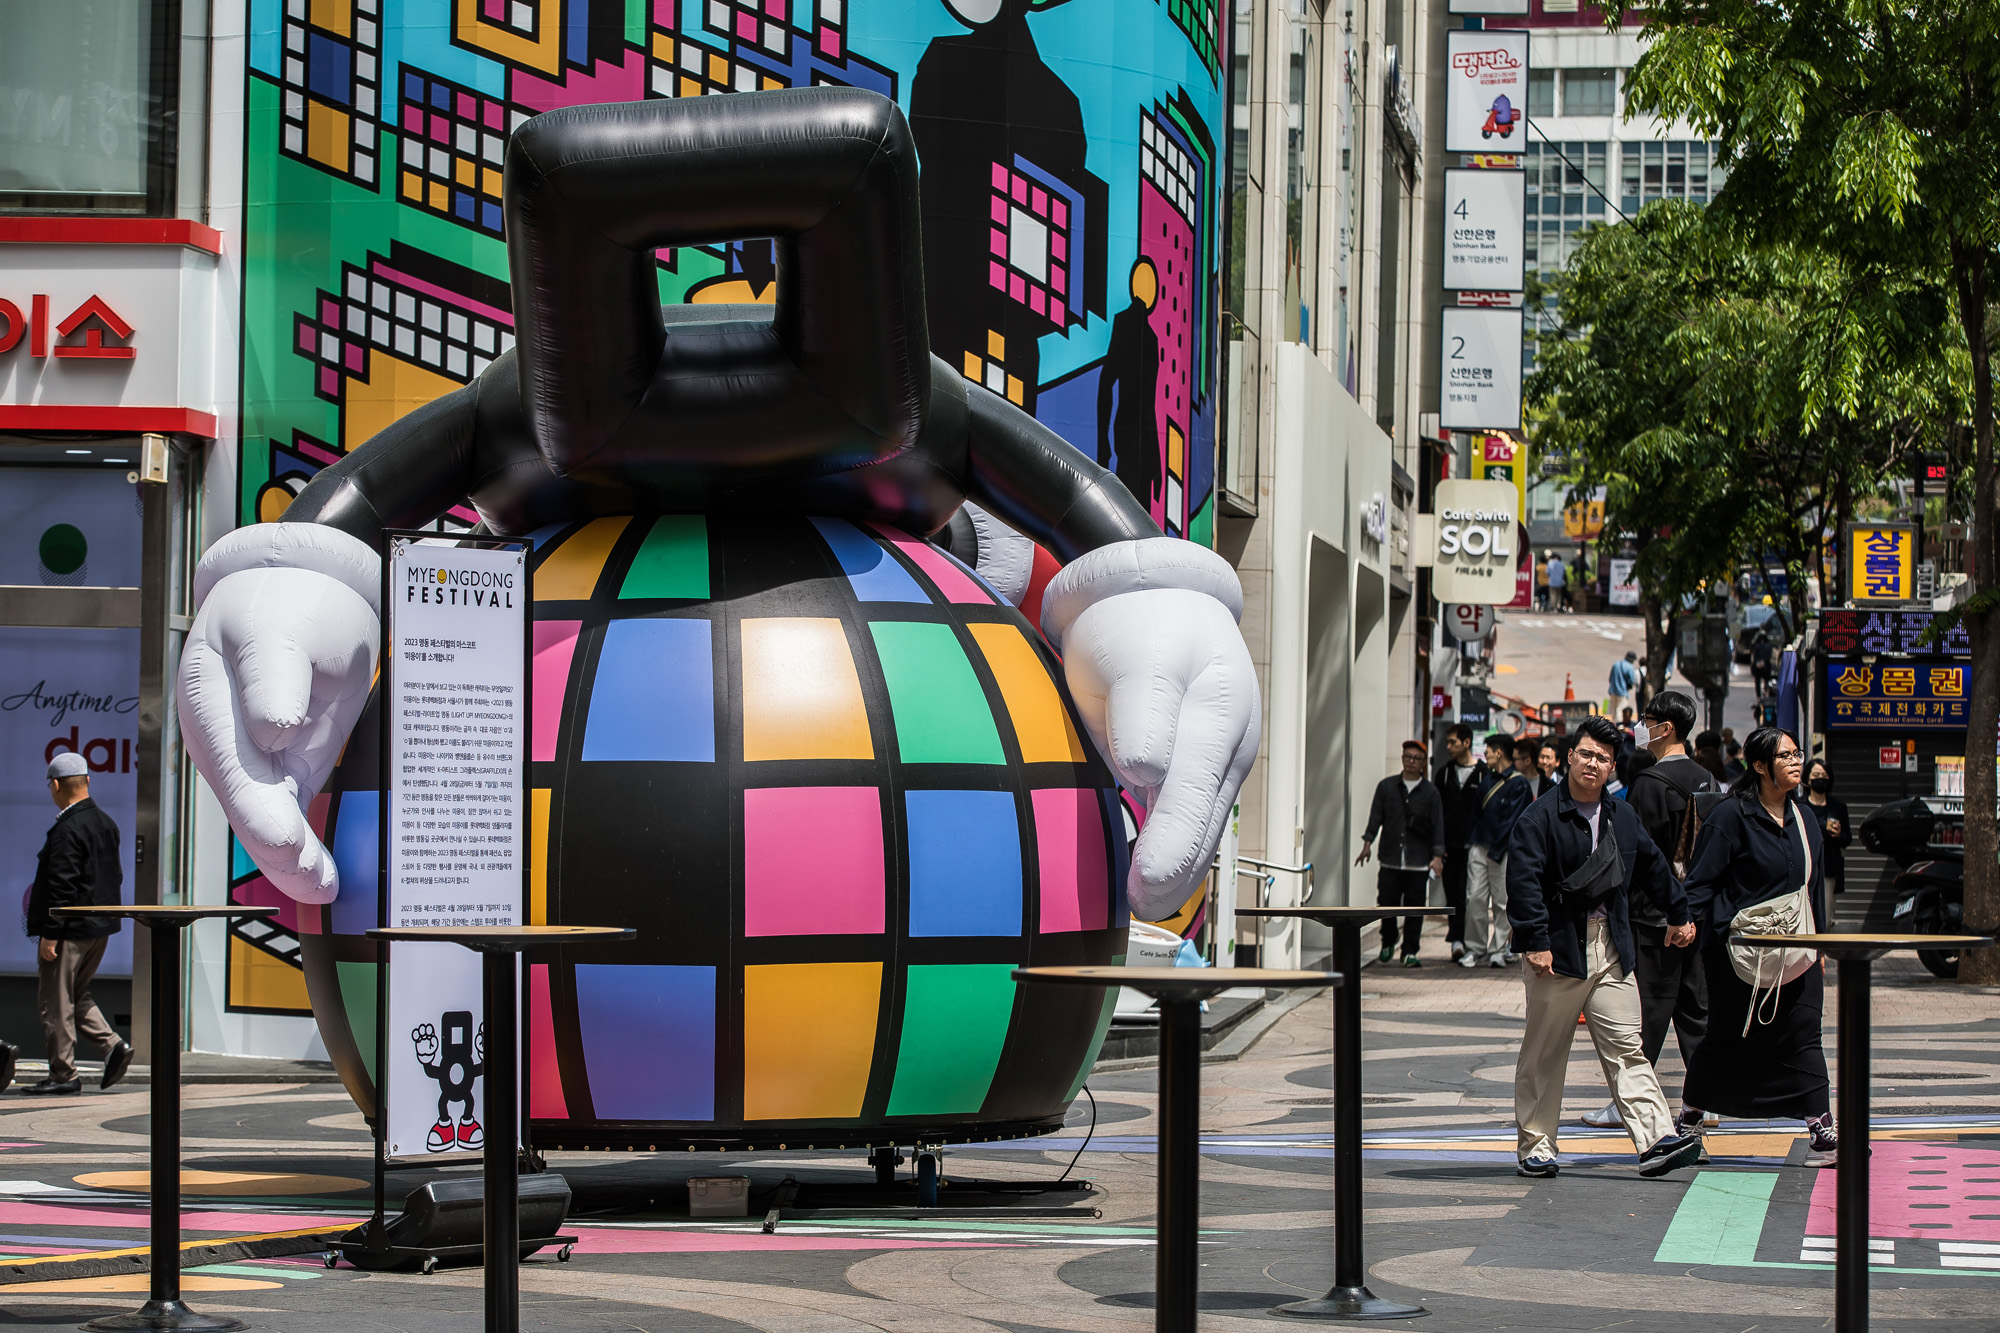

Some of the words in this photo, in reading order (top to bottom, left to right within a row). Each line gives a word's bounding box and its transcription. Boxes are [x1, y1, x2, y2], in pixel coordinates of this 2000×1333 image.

[1453, 198, 1468, 220] 4
[1453, 229, 1496, 240] 신한은행
[1451, 336, 1465, 359] 2
[1450, 368, 1493, 379] 신한은행
[1449, 394, 1477, 402] 명동지점
[1442, 508, 1473, 521] Café
[1475, 509, 1511, 521] Swith
[1440, 525, 1510, 556] SOL
[1863, 530, 1903, 597] 상품권
[408, 567, 513, 588] MYEONGDONG
[408, 586, 513, 608] FESTIVAL
[1456, 604, 1483, 633] 약
[404, 638, 418, 646] 2023
[419, 638, 429, 648] 명동
[1836, 667, 1963, 696] 상품권
[2, 680, 113, 727] Anytime
[1860, 702, 1963, 716] 국제전화카드
[44, 726, 139, 774] dai
[437, 849, 449, 857] 2023
